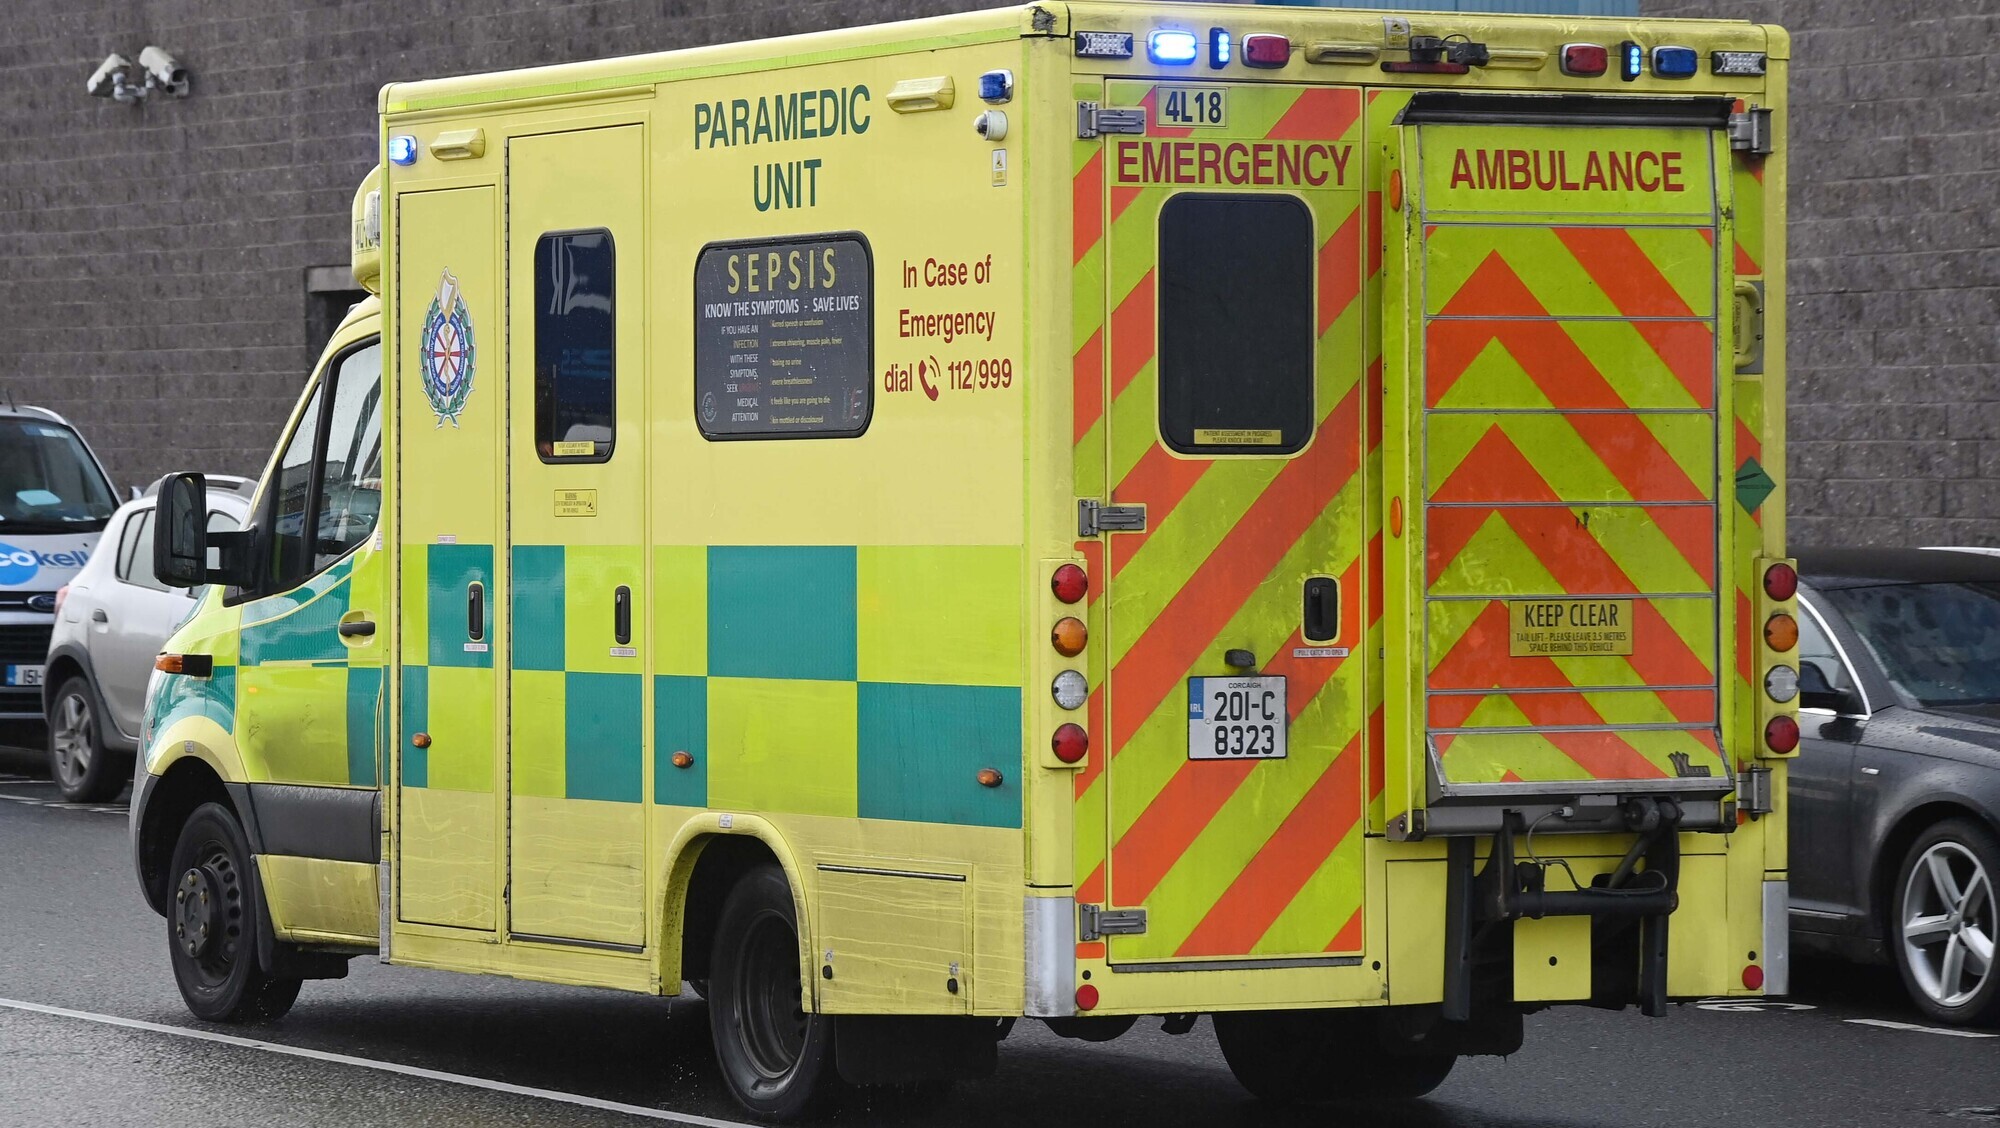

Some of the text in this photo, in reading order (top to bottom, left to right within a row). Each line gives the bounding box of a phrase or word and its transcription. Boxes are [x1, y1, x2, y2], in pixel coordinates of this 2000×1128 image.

[694, 84, 871, 150] PARAMEDIC
[1165, 91, 1222, 124] 4L18
[1118, 141, 1353, 186] EMERGENCY
[1450, 148, 1685, 192] AMBULANCE
[753, 158, 822, 212] UNIT
[727, 248, 836, 294] SEPSIS
[903, 254, 991, 288] In Case of
[705, 303, 732, 318] KNOW
[733, 302, 750, 316] THE
[751, 299, 799, 316] SYMPTOMS
[812, 297, 835, 312] SAVE
[836, 295, 859, 312] LIVES
[721, 324, 758, 335] IF YOU HAVE AN
[899, 309, 996, 344] Emergency
[733, 339, 758, 348] INFECTION
[729, 353, 758, 363] WITH THESE
[726, 383, 738, 392] SEEK
[884, 358, 1012, 393] dial 112/999
[736, 398, 758, 407] MEDICAL
[731, 412, 758, 422] ATTENTION
[1524, 603, 1618, 627] KEEP CLEAR
[1516, 633, 1530, 642] TAIL
[1531, 632, 1544, 642] LIFT
[1549, 632, 1571, 641] PLEASE
[1572, 632, 1591, 641] LEAVE
[1592, 632, 1602, 641] 3.5
[1603, 631, 1626, 641] METRES
[1529, 642, 1613, 652] SPACE BEHIND THIS VEHICLE
[1190, 703, 1203, 713] IRL
[1214, 691, 1275, 721] 201-C
[1214, 725, 1275, 756] 8323
